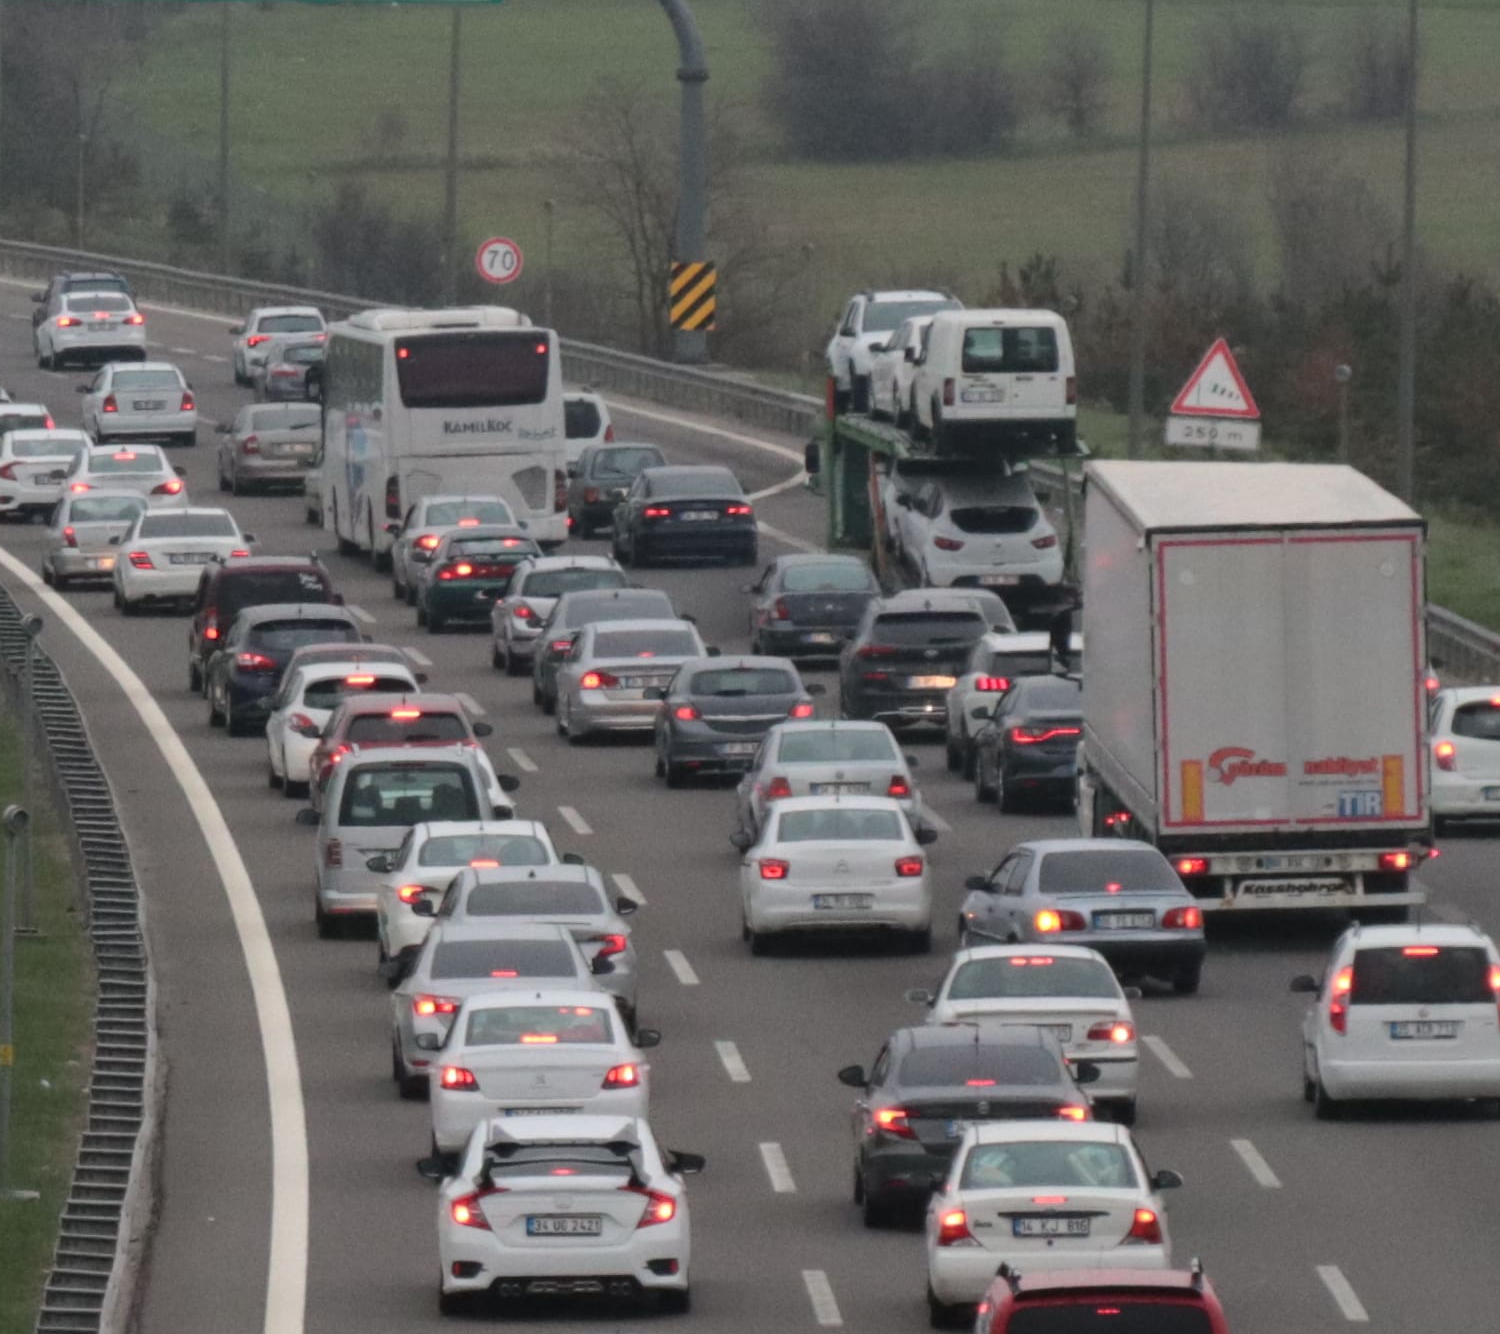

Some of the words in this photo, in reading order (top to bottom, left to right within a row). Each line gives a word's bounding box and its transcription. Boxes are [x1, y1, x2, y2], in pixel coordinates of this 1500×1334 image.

[488, 250, 514, 271] 70
[1183, 426, 1218, 439] 250
[1227, 432, 1242, 441] m
[1340, 792, 1382, 816] TIR
